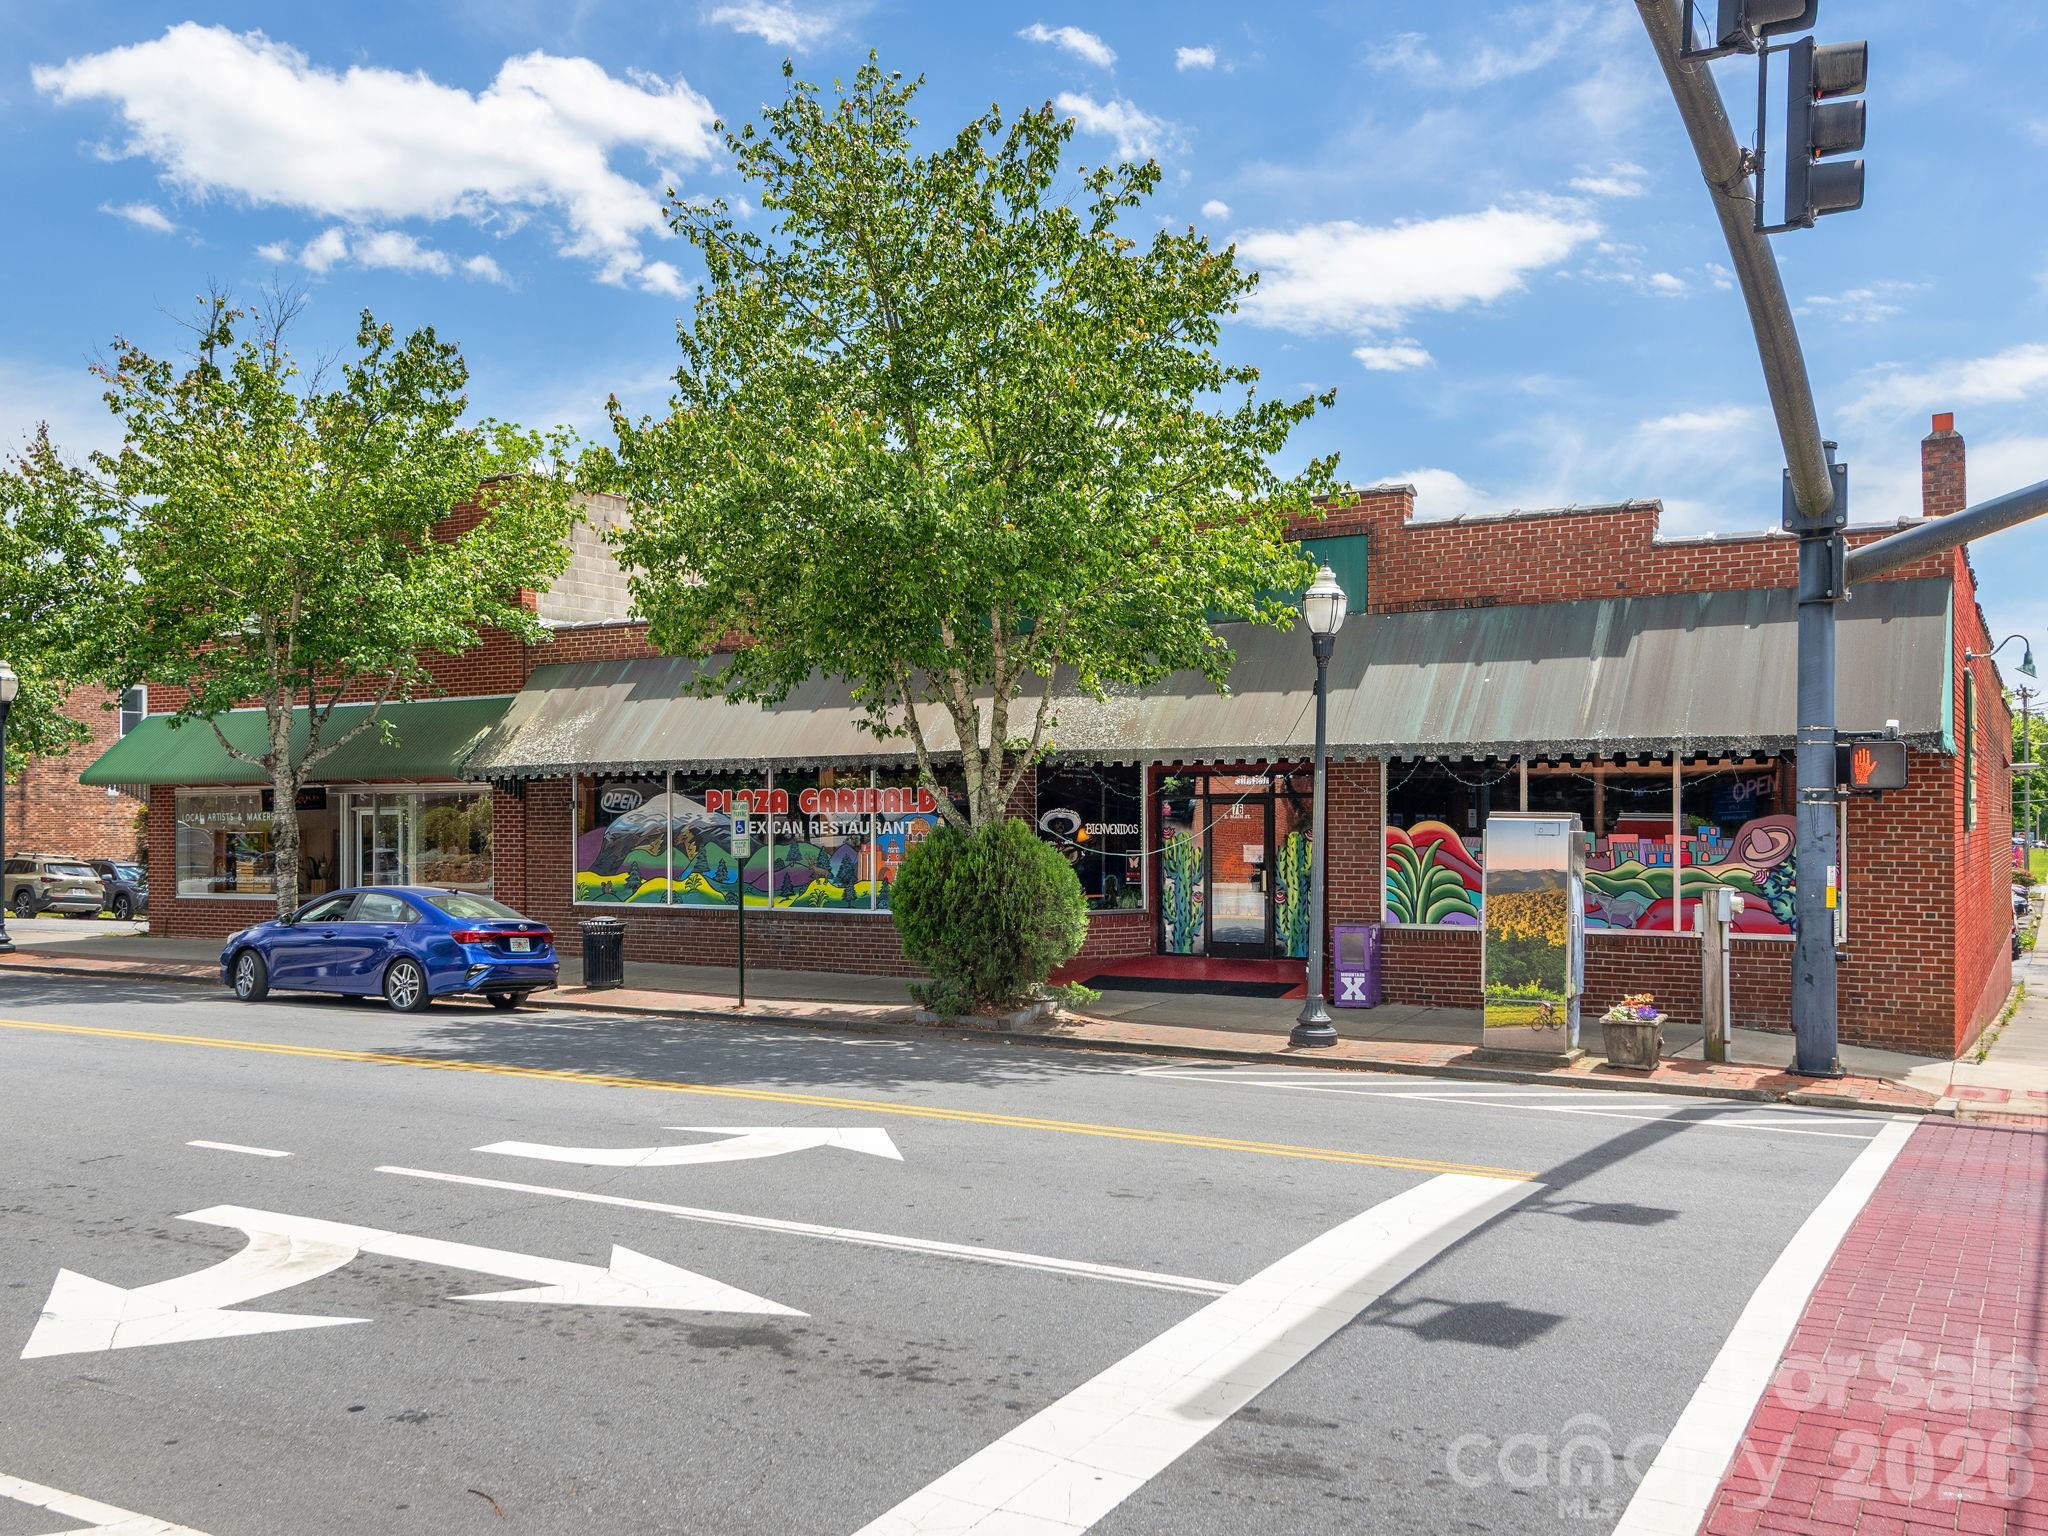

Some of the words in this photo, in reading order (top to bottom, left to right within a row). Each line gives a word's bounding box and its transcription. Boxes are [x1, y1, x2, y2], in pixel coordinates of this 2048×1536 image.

[1733, 774, 1778, 801] OPEN
[603, 792, 637, 810] OPEN
[207, 812, 234, 821] ARTISTS
[237, 812, 242, 821] &
[1232, 804, 1243, 814] 76
[748, 820, 803, 835] EXCAN
[808, 820, 916, 835] RESTAURANT
[1085, 822, 1139, 835] BIENVENIDOS
[1340, 977, 1366, 1001] X
